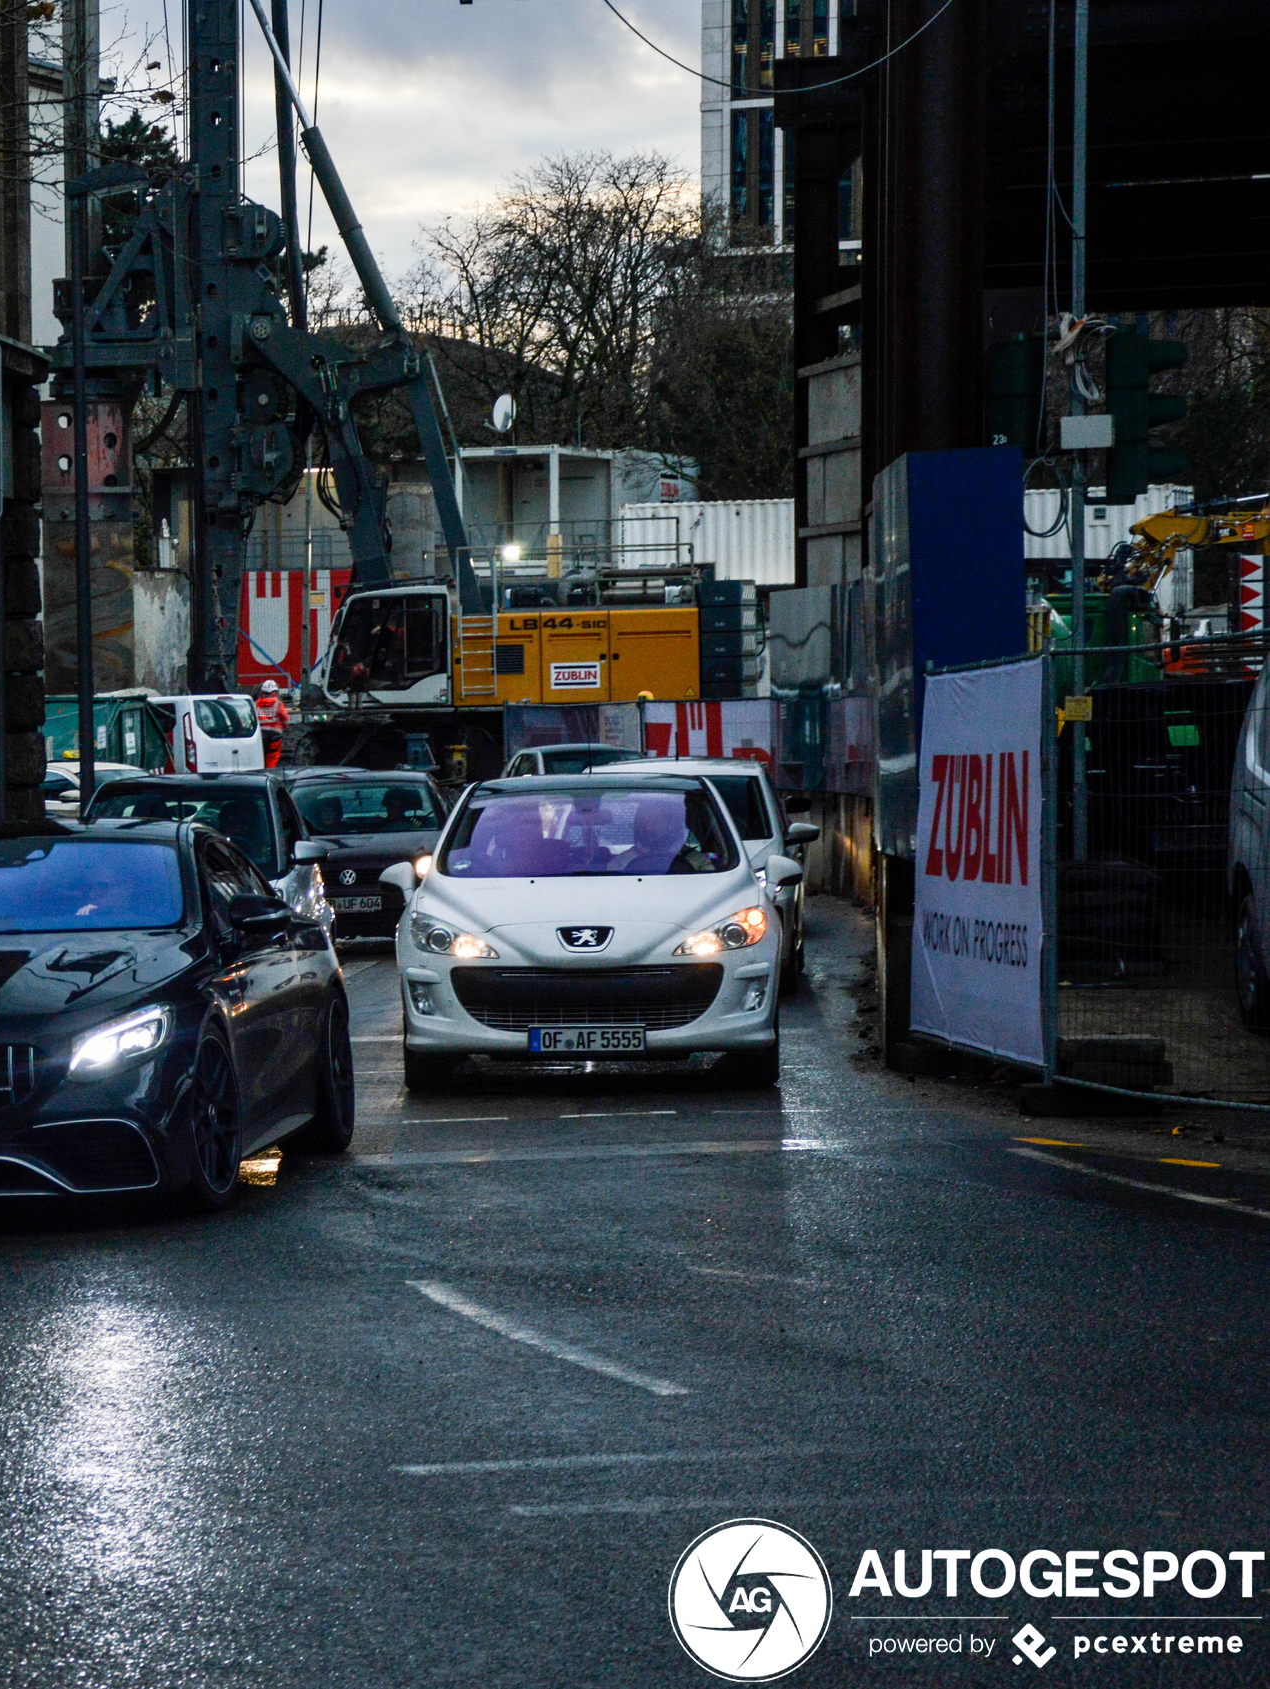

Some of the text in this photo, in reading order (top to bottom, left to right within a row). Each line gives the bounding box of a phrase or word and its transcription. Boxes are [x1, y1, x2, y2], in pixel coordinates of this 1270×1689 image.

[510, 619, 538, 630] LB
[925, 750, 1029, 886] ZÜBLIN
[360, 897, 380, 909] 604
[923, 909, 1028, 968] WORK ON PROGRESS
[542, 1031, 642, 1049] OF AF 5555
